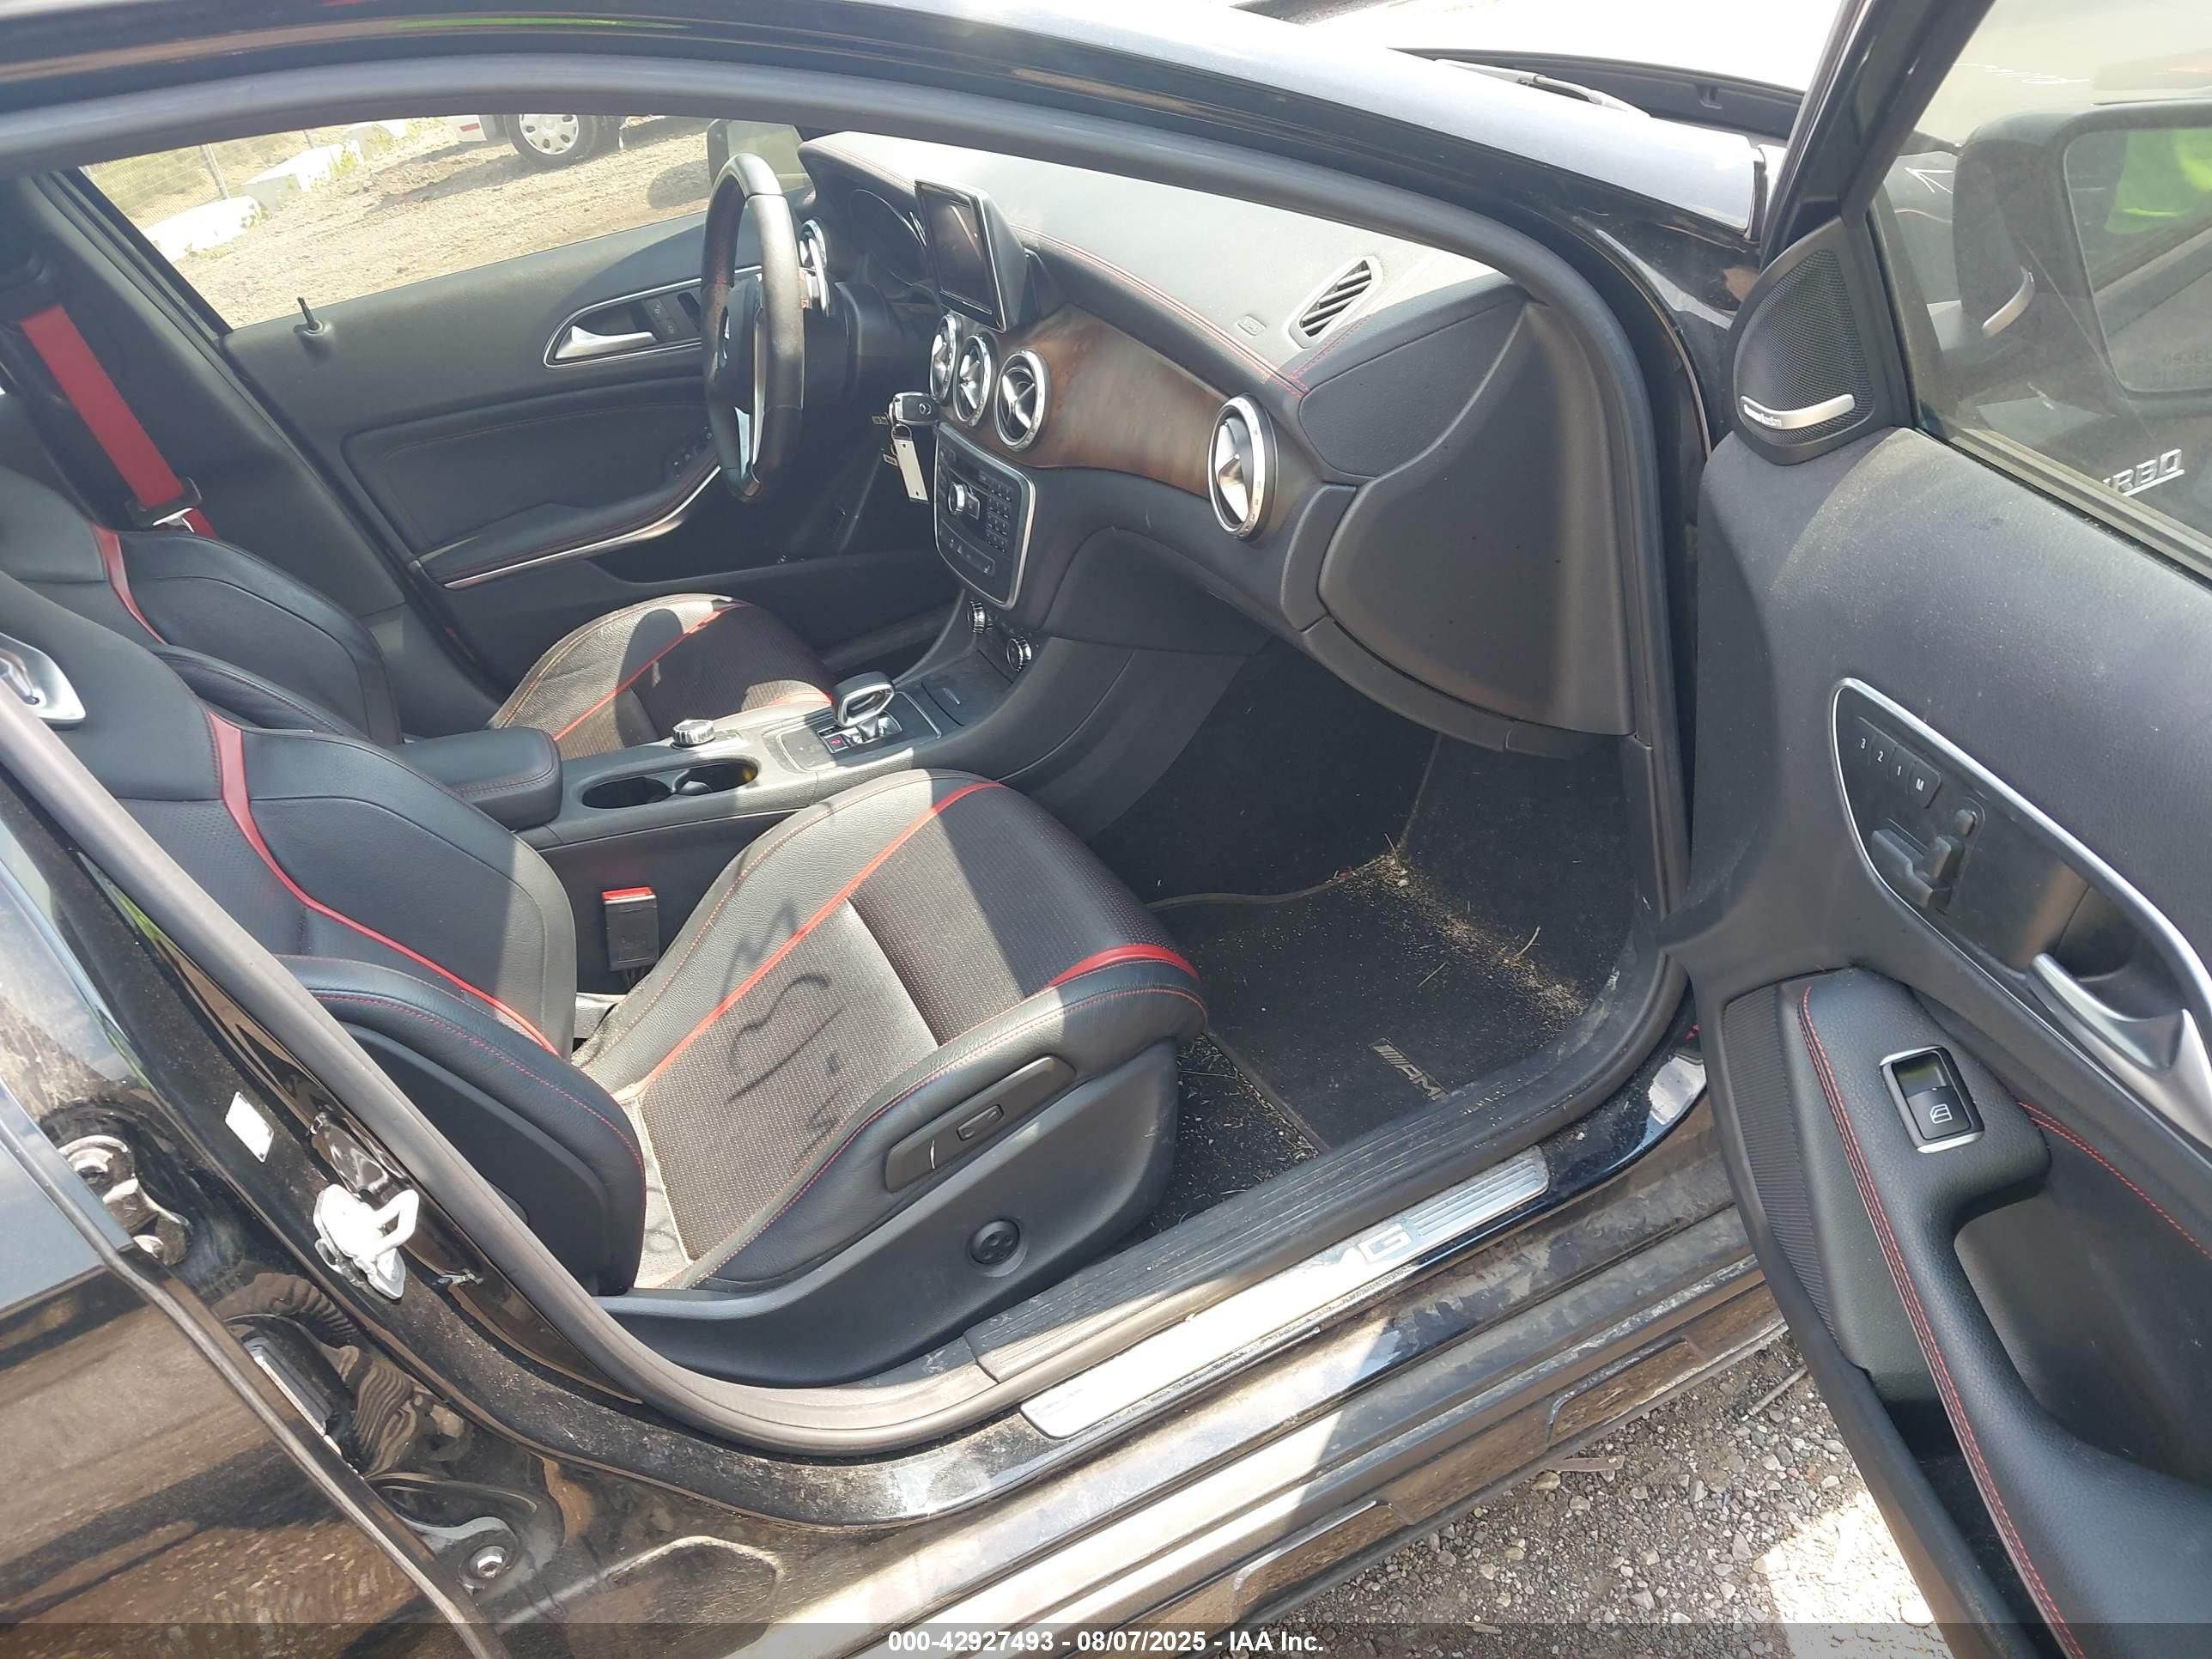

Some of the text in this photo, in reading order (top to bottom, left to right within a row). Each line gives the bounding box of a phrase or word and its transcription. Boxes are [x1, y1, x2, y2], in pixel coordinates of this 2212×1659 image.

[1860, 738, 1866, 750] 3
[1877, 750, 1884, 763] 2
[1896, 766, 1901, 776] 1
[1916, 778, 1924, 792] M
